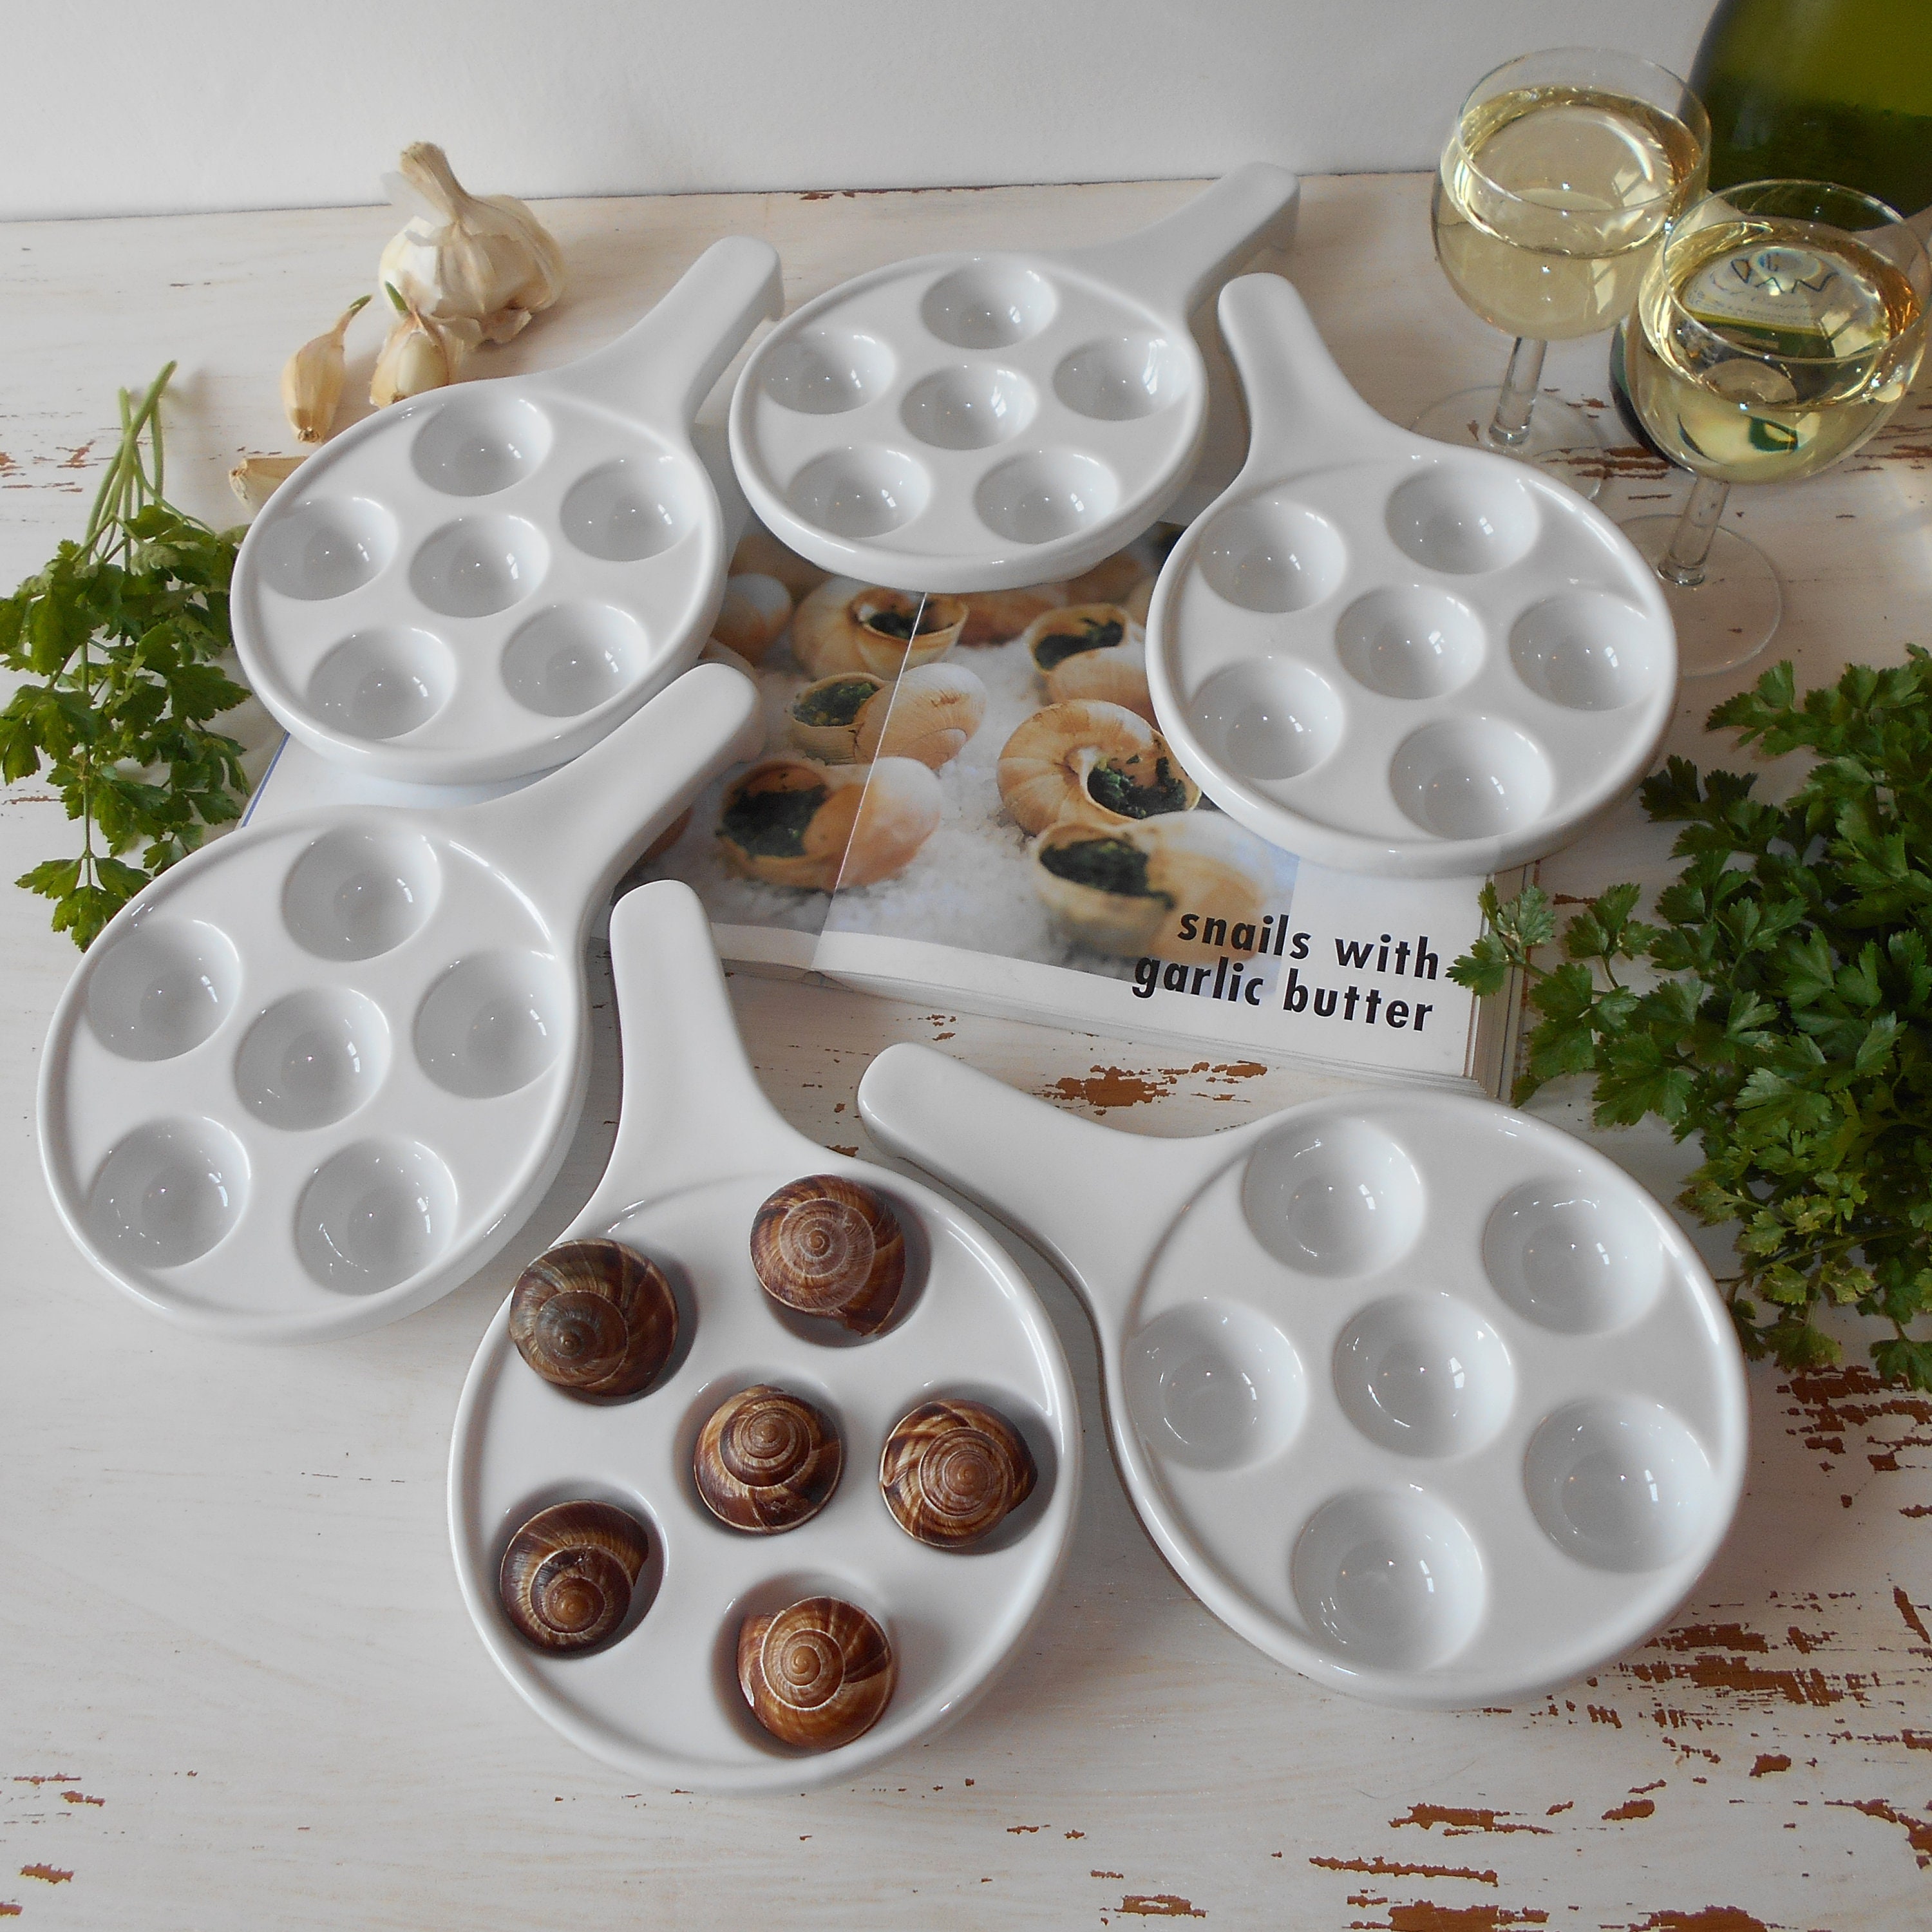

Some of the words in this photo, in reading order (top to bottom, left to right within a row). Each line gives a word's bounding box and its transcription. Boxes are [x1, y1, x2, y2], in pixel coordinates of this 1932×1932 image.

[1177, 913, 1311, 960] snails
[1335, 934, 1439, 980] with
[1132, 956, 1264, 1006] garlic
[1283, 967, 1433, 1032] butter
